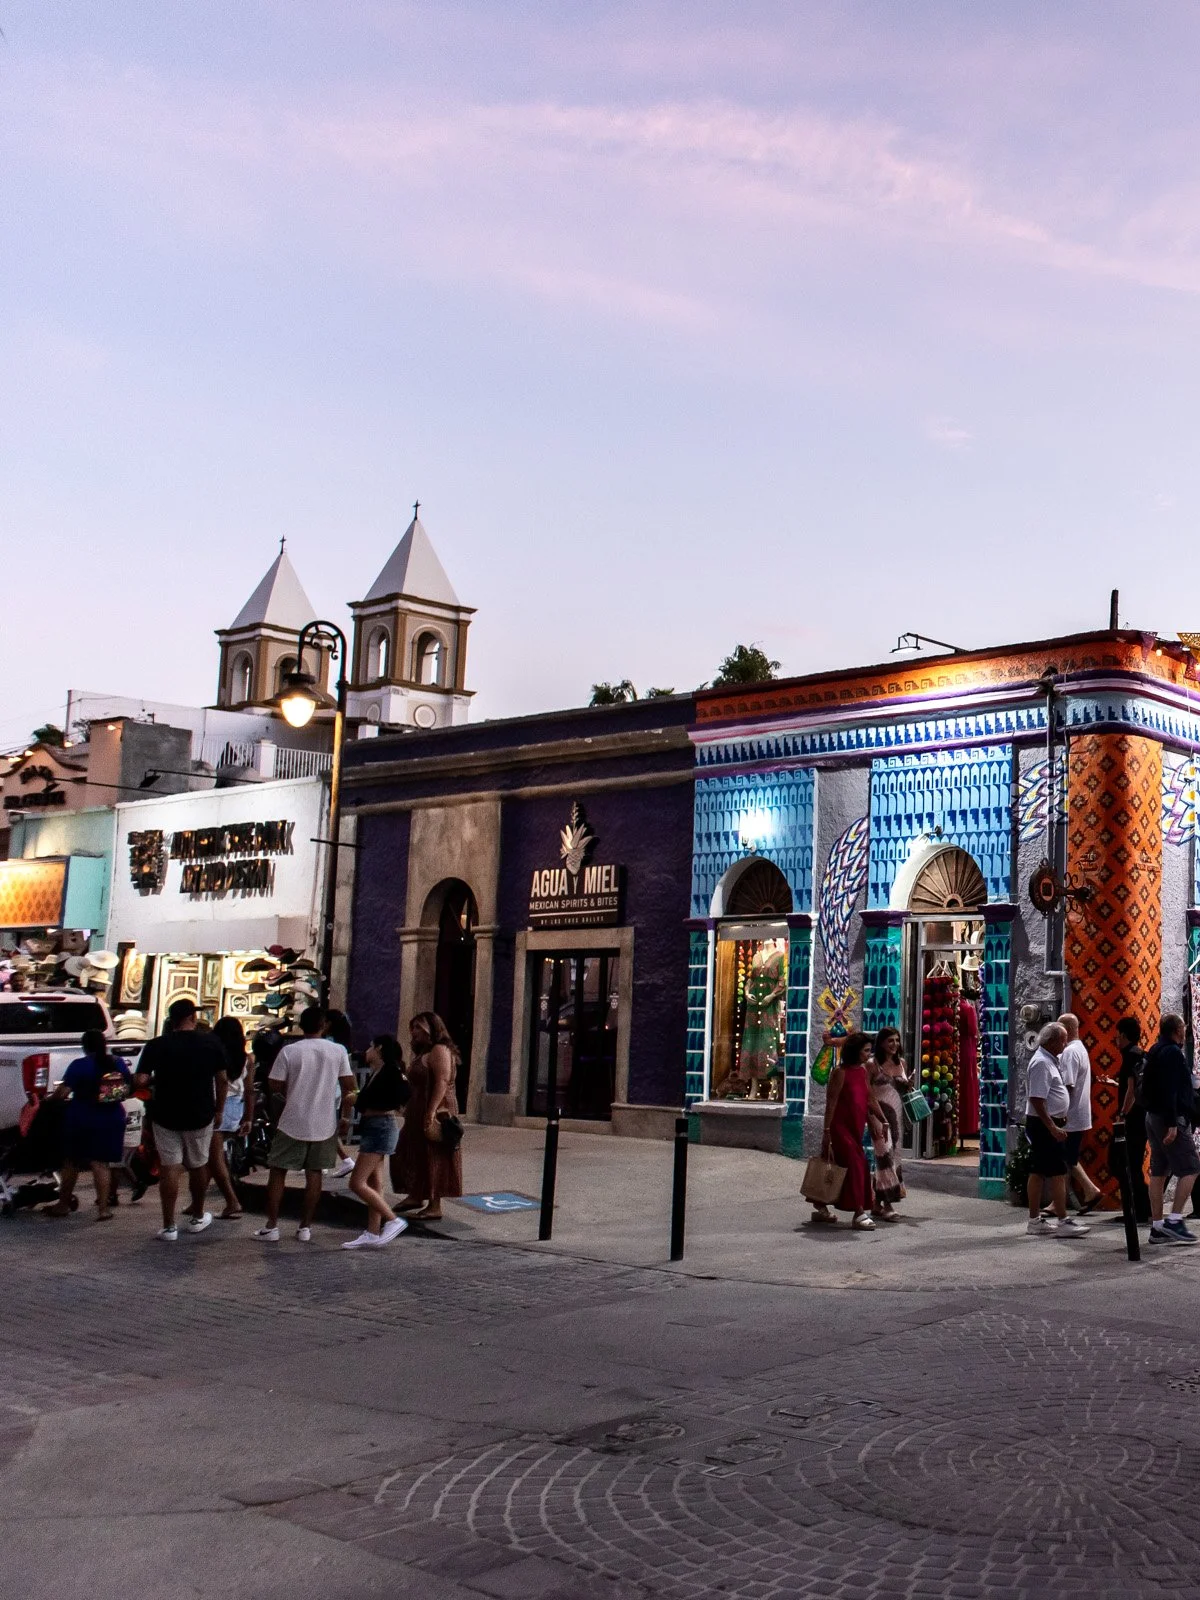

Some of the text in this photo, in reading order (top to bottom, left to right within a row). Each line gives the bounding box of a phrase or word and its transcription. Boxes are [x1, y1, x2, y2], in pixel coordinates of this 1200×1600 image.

[531, 865, 619, 898] AGUA Y MIEL
[529, 897, 618, 910] MEXICAN SPIRITS & BITES
